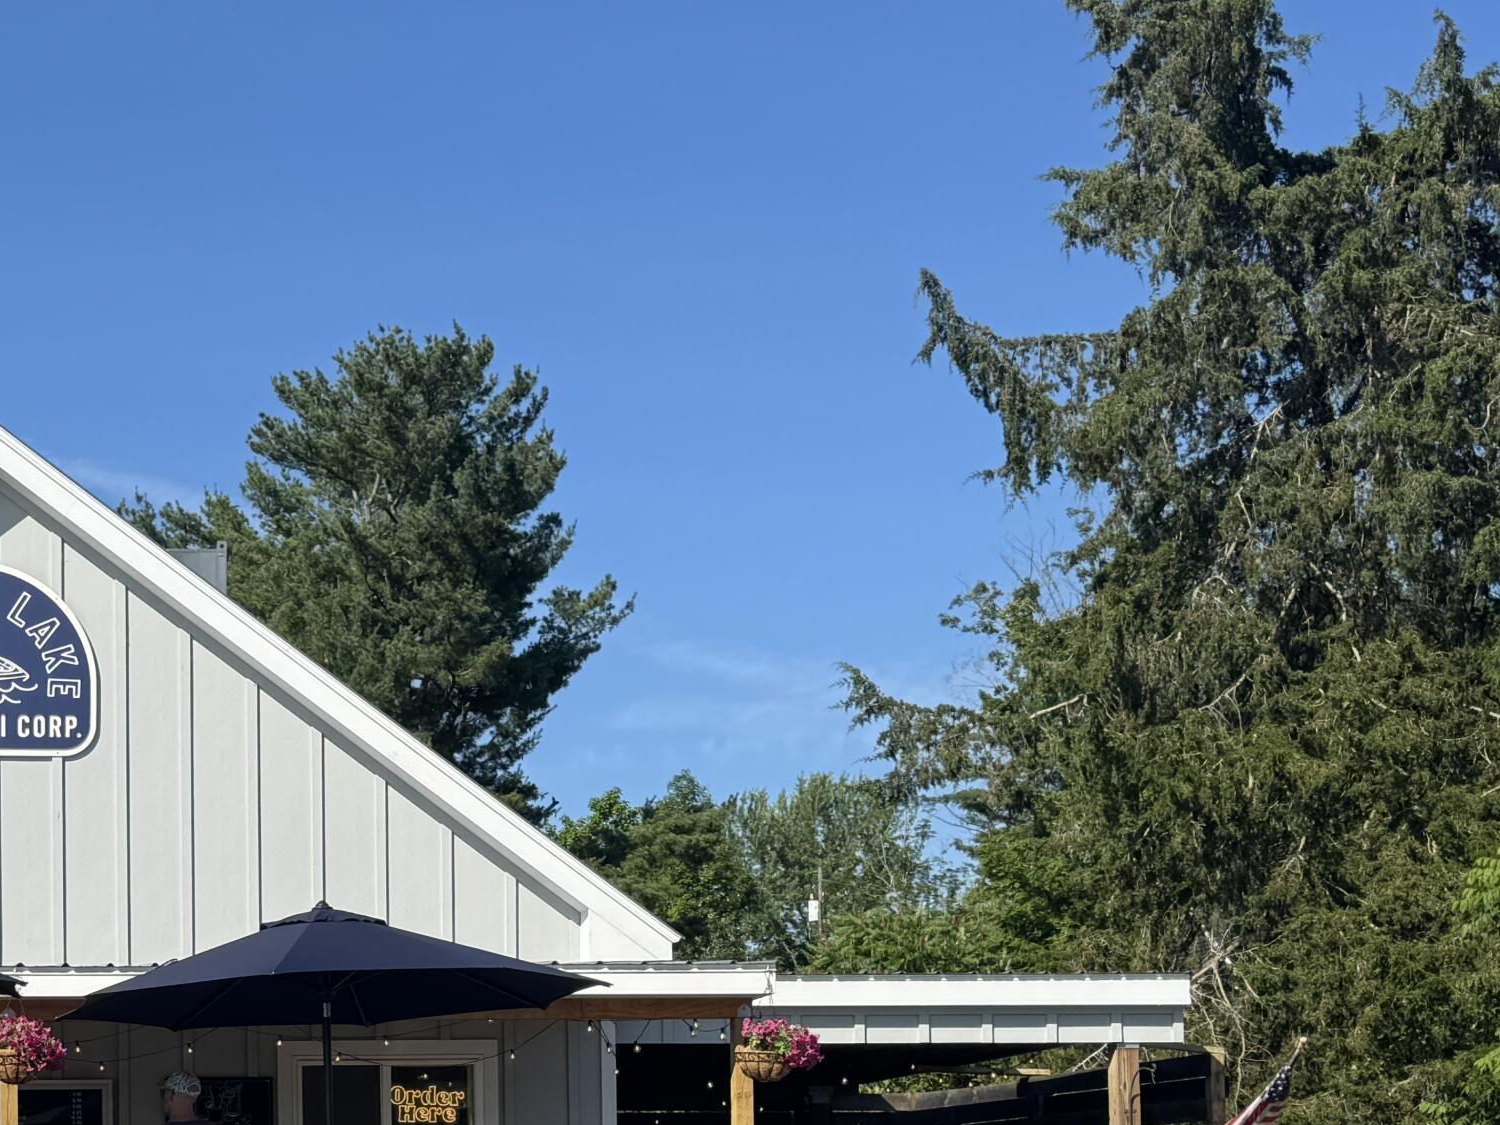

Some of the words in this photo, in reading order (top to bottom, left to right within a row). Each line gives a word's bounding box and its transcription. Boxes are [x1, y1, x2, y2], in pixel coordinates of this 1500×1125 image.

[6, 591, 82, 699] LAKE
[17, 714, 82, 738] CORP.
[390, 1085, 465, 1107] Order
[398, 1104, 457, 1123] Here
